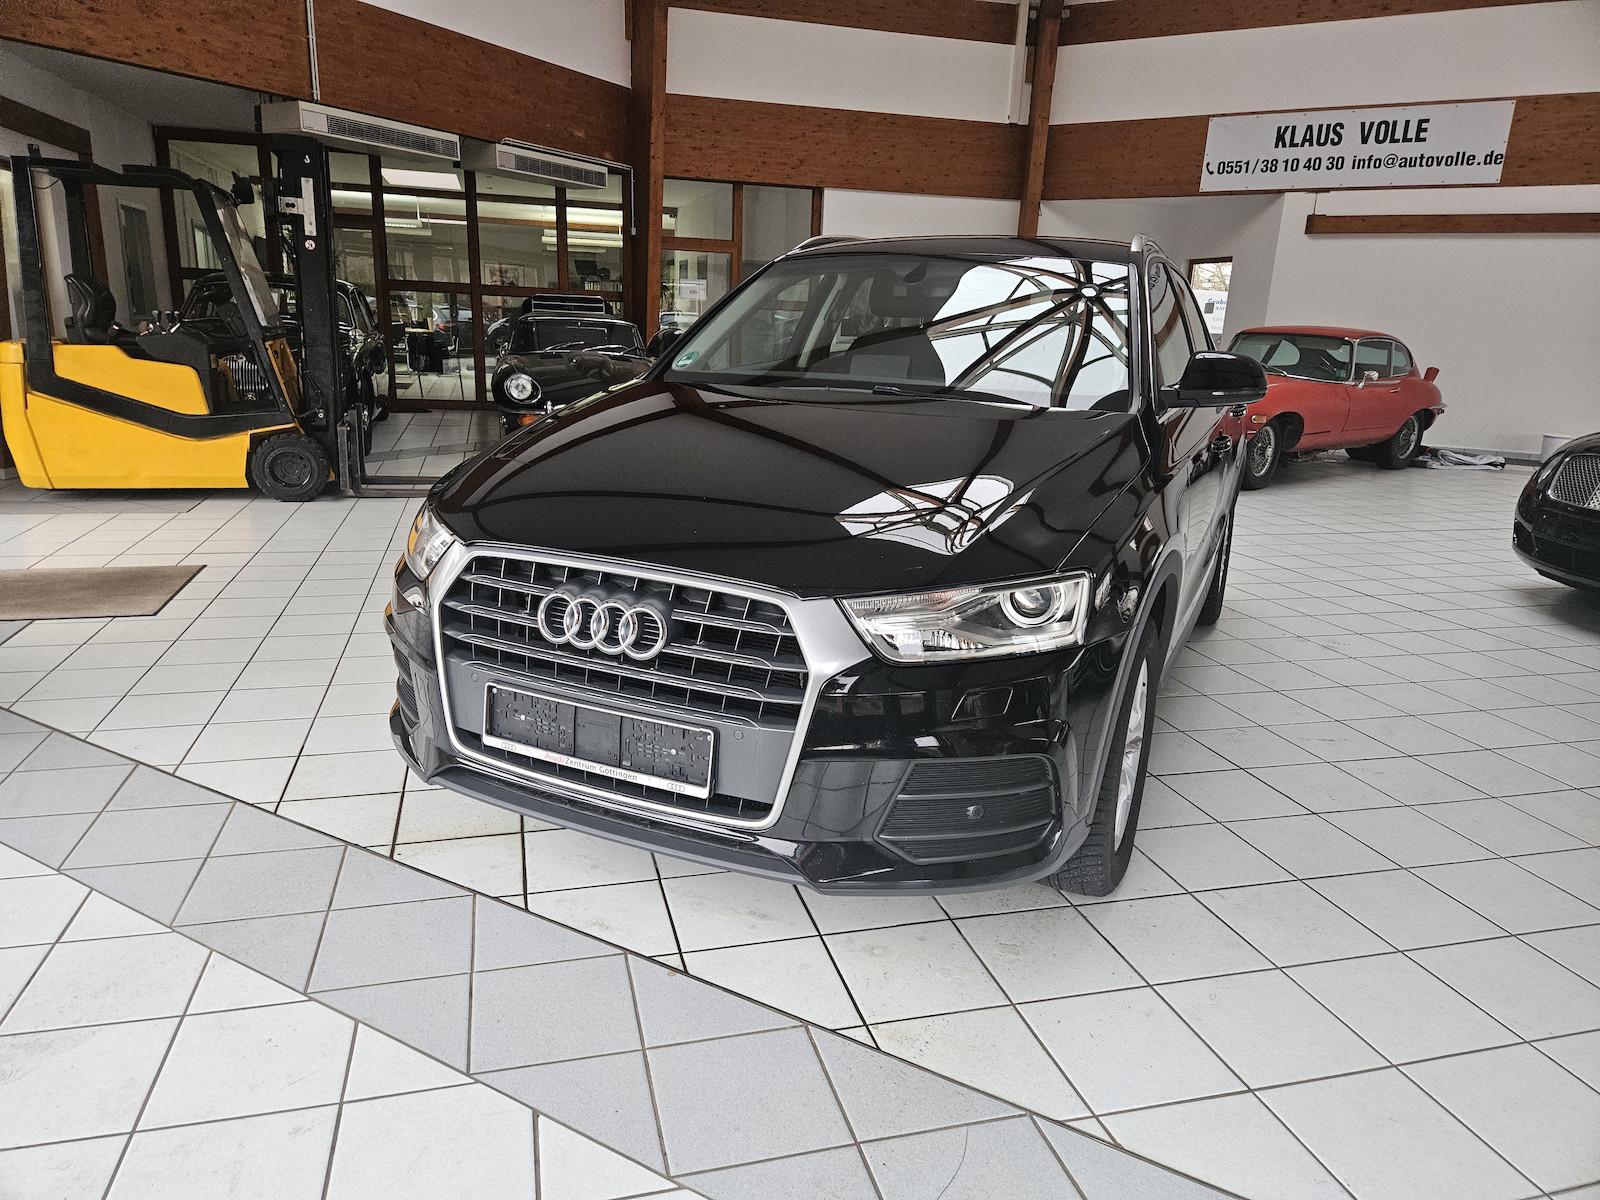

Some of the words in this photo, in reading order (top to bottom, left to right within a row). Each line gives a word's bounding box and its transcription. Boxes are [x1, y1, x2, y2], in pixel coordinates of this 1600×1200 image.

[1274, 122, 1344, 149] KLAUS
[1360, 118, 1430, 145] VOLLE
[1282, 157, 1300, 172] 10
[1303, 156, 1322, 171] 40
[1326, 156, 1345, 171] 30
[1351, 150, 1504, 170] info@autovolle.de
